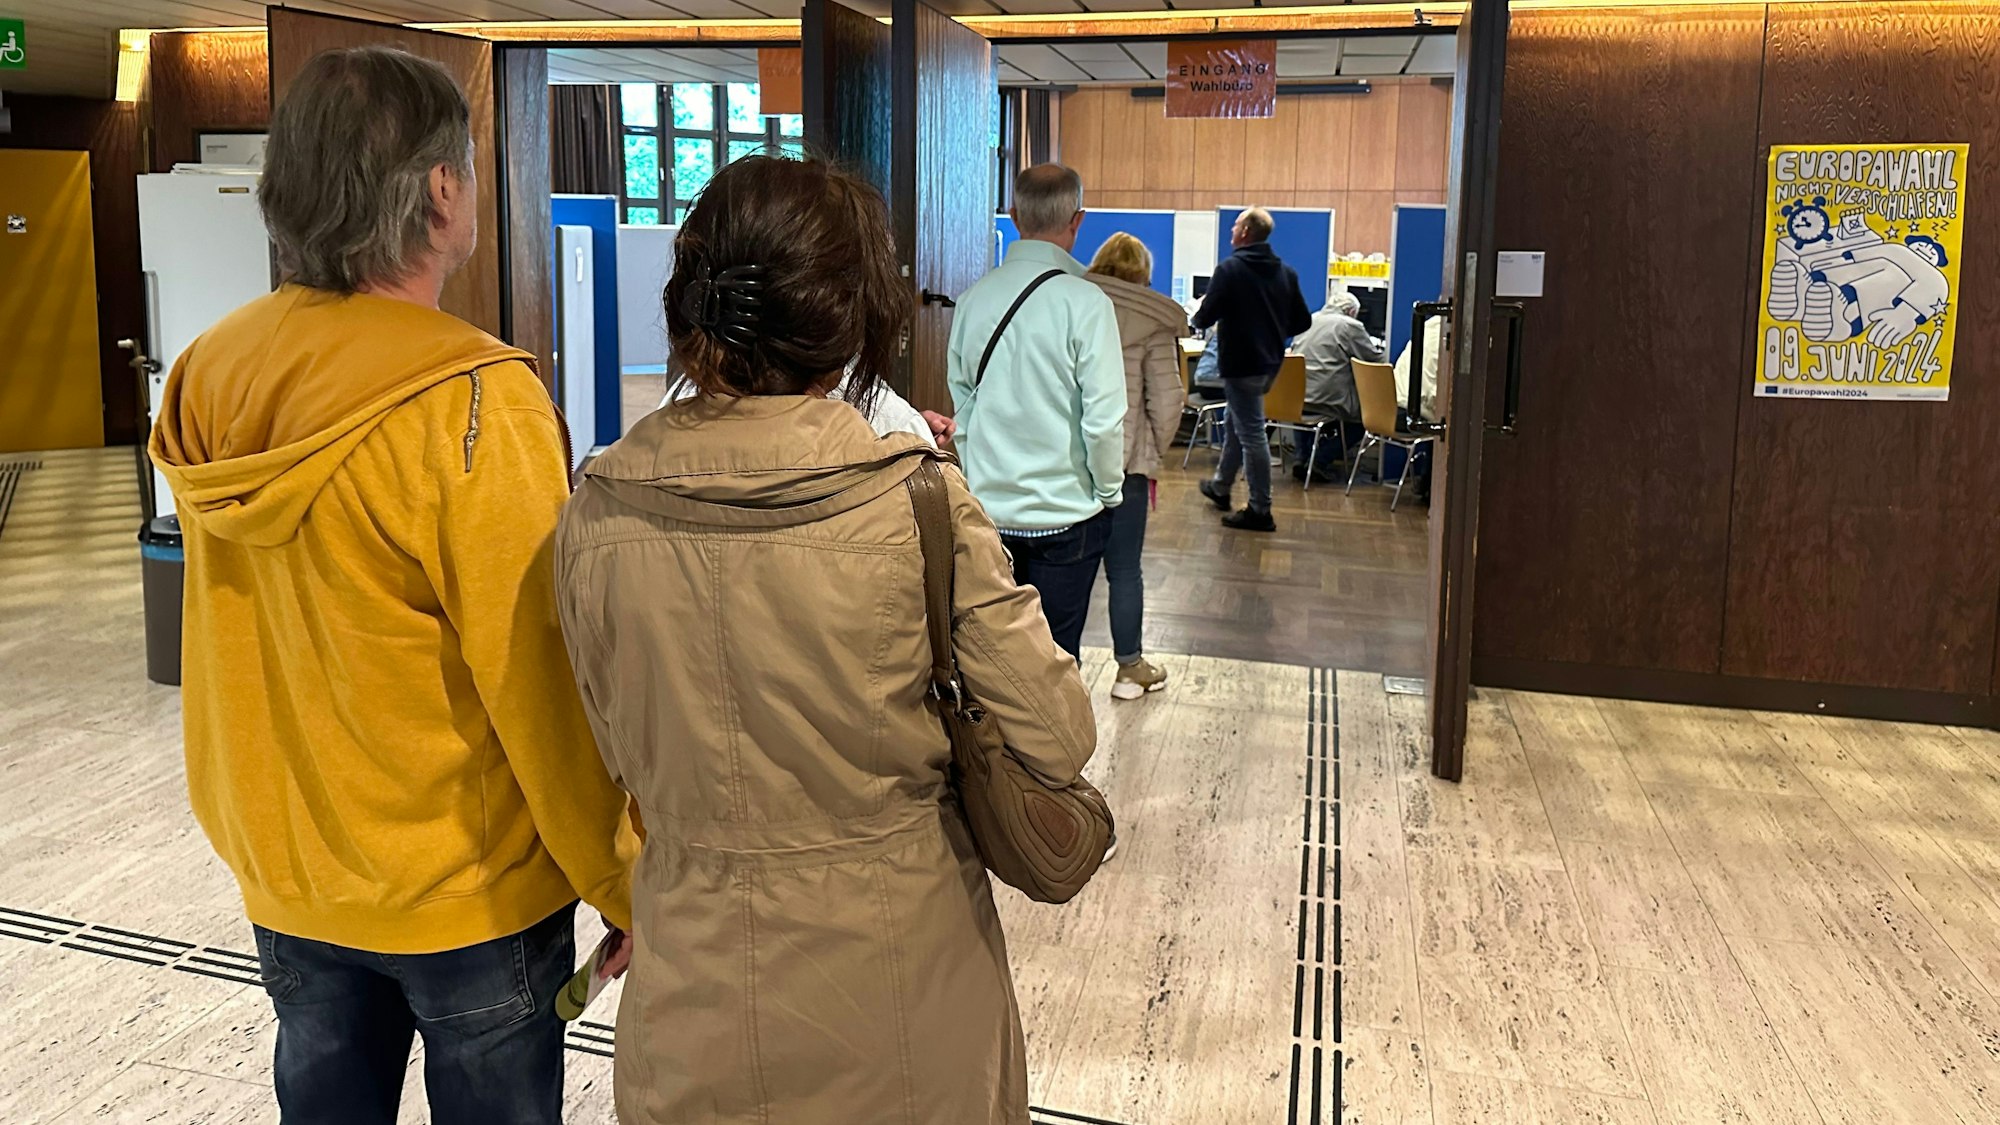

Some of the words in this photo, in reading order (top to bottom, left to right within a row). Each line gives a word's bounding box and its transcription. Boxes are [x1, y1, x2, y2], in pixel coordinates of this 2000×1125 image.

[1180, 64, 1266, 76] EINGANG
[1190, 80, 1254, 92] Wahlbüro
[1775, 150, 1958, 192] EUROPAWAHL
[1775, 181, 1833, 204] NICHT
[1833, 183, 1957, 222] VERSCHLAFEN!
[1763, 326, 1808, 381] 09.
[1807, 342, 1878, 383] JUNI
[1878, 328, 1942, 384] 2024
[1782, 387, 1868, 398] #Europawahl2024
